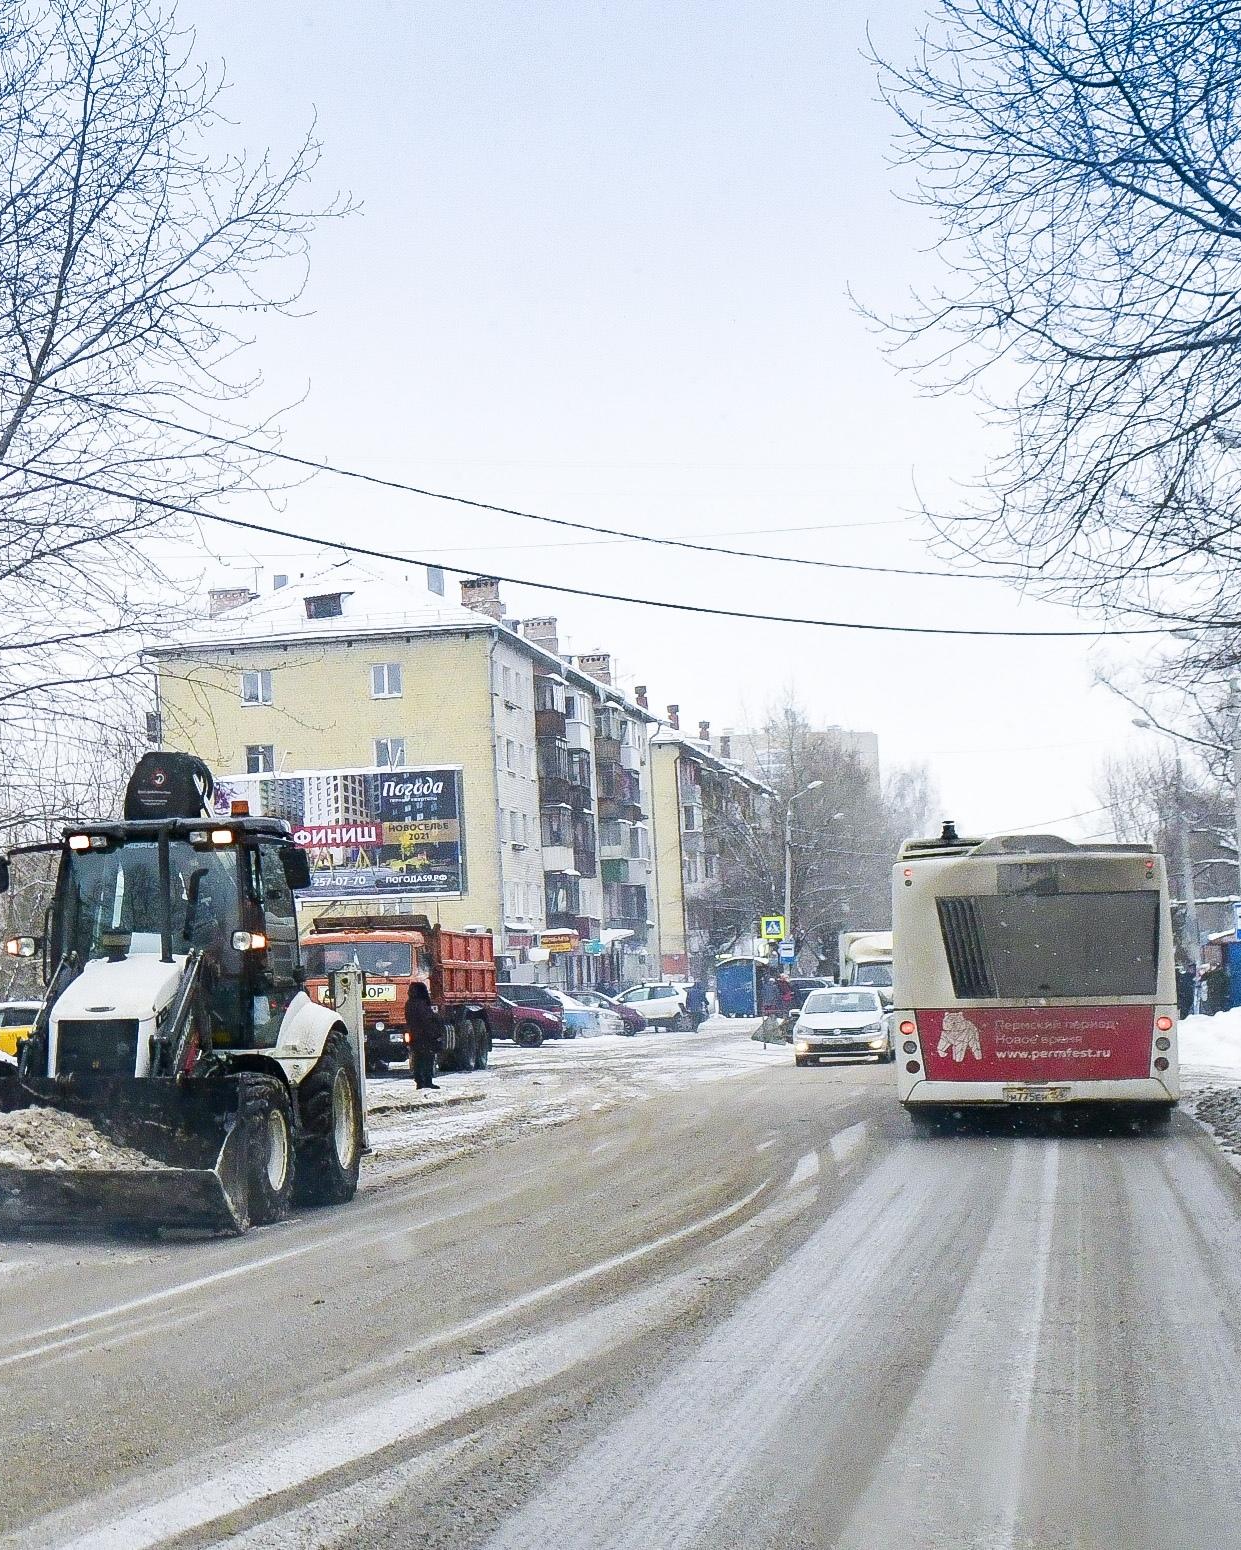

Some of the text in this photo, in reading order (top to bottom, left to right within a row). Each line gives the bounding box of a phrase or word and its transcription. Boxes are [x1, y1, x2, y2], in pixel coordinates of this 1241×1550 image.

[382, 777, 444, 801] Погода
[388, 822, 449, 832] НОВОСЕЛЬЕ
[293, 826, 377, 844] ФИНИШ
[408, 832, 429, 841] 2021
[313, 876, 366, 887] 257-07-70
[385, 873, 448, 884] ПОГОДА59.РФ
[995, 1035, 1083, 1045] Новое время
[996, 1048, 1111, 1060] www.permfest.ru
